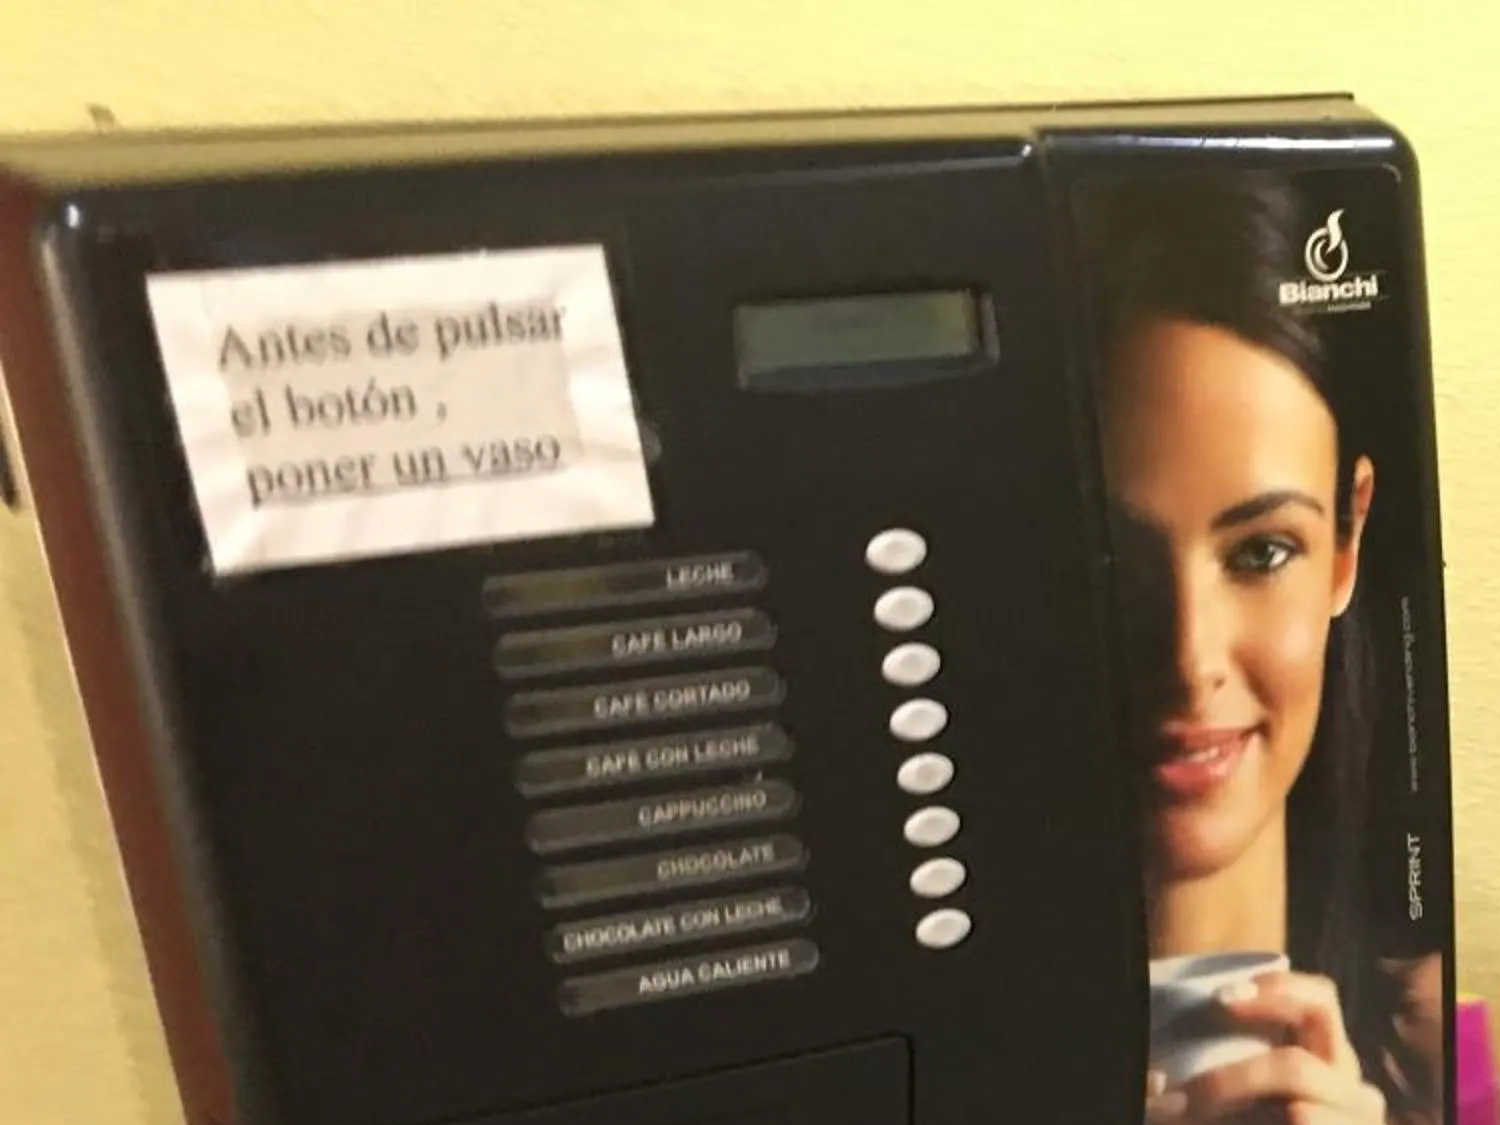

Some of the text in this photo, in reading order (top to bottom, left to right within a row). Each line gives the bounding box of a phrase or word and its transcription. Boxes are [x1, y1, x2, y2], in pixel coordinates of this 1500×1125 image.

[1279, 273, 1379, 306] Bianchi
[219, 301, 567, 372] Antes de pulsar
[231, 387, 271, 437] el
[284, 376, 416, 430] botón
[248, 434, 562, 511] poner un vaso
[666, 561, 734, 591] LECHE
[671, 621, 743, 651] LARGO
[653, 680, 751, 712] CORTADO
[645, 745, 690, 771] CON
[693, 734, 760, 765] LECHE
[638, 788, 768, 828] CAPPUCCINO
[657, 843, 776, 881] CHOCOLATE
[1407, 833, 1424, 922] SPRINT
[563, 896, 783, 953] CHOCOLATE CON LECHE
[638, 948, 791, 995] AGUA CALIENTE
